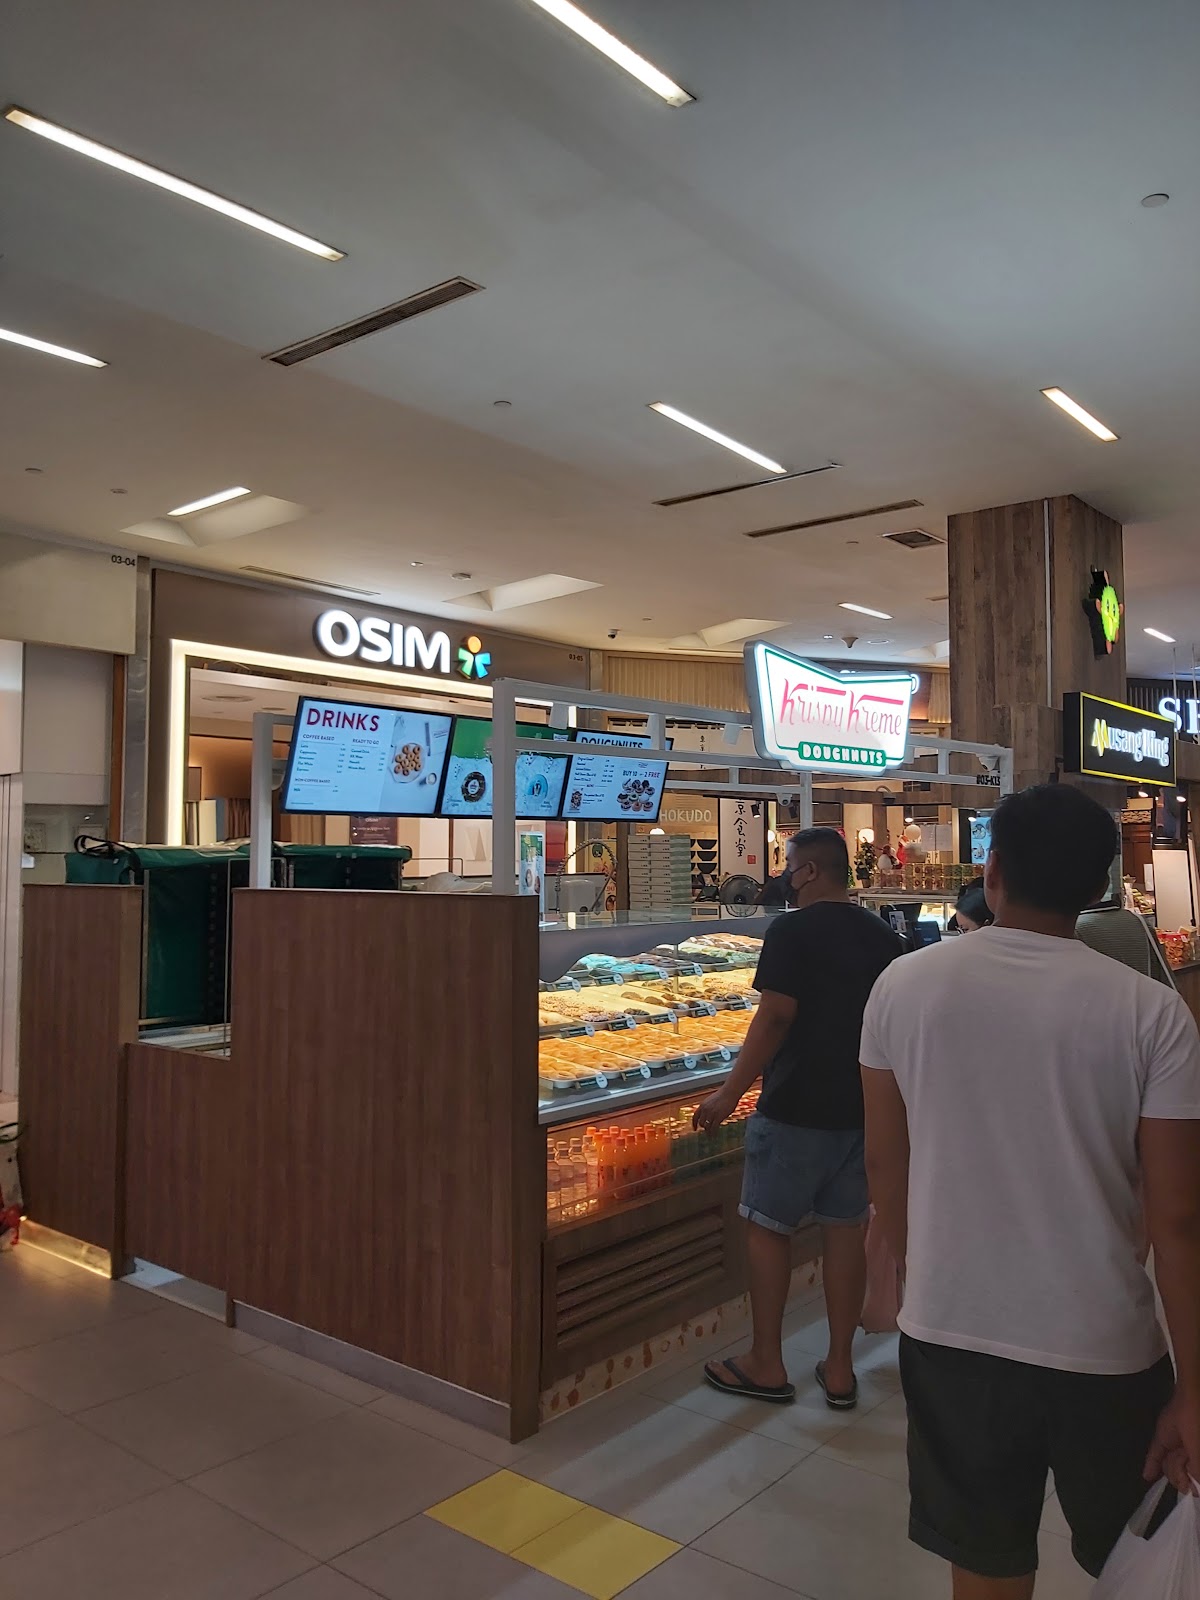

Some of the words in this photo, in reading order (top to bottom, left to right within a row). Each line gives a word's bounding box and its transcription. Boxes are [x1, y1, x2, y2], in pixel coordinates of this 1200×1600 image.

[111, 554, 136, 567] 03-04
[315, 608, 451, 674] OSIM
[306, 707, 381, 732] DRINKS
[846, 689, 905, 736] Kreme
[302, 733, 320, 741] COFFEE
[802, 744, 884, 765] DOUGHNUTS
